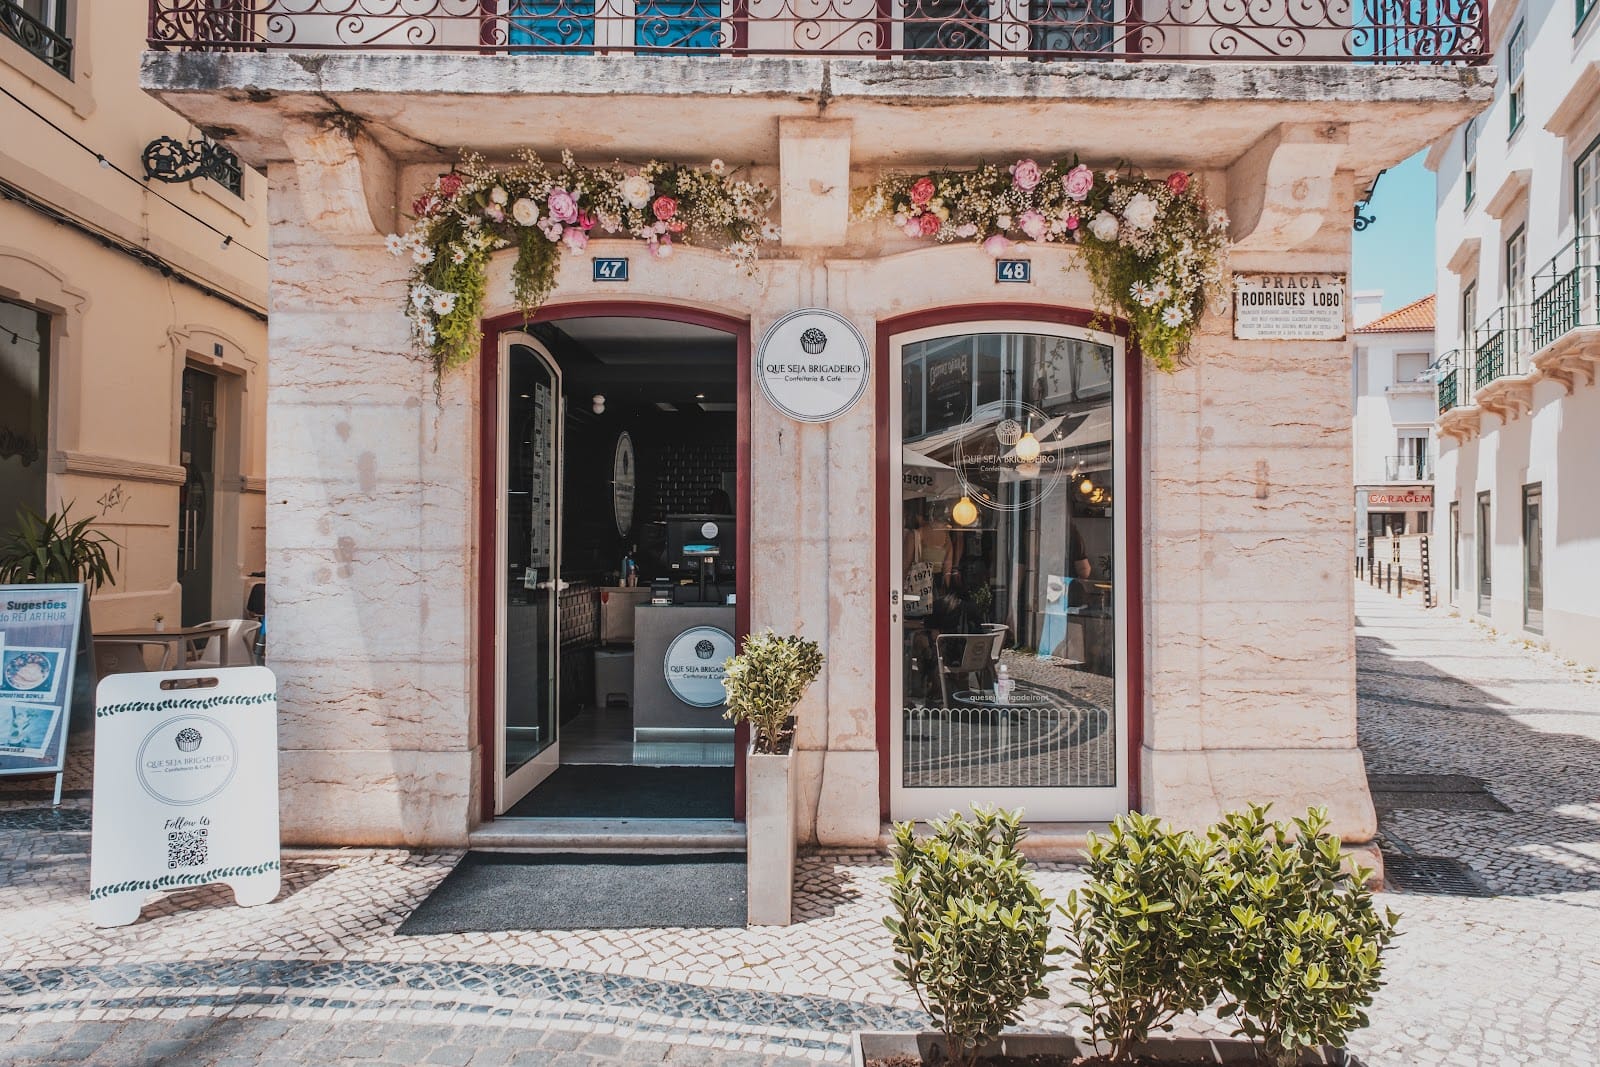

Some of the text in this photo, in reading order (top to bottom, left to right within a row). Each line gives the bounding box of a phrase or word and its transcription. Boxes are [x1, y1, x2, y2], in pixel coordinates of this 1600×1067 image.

[600, 261, 622, 278] 47
[1002, 262, 1025, 279] 48
[1241, 291, 1340, 307] RODRIGUES LOBO
[766, 364, 861, 374] QUE SEJA BRIGADEIRO
[962, 455, 982, 465] QUE
[983, 455, 1002, 464] SEJA
[6, 599, 67, 613] Sugestões
[12, 612, 27, 622] REI
[30, 611, 66, 622] ARTHUR
[670, 665, 685, 673] QUE
[686, 665, 699, 673] SEJA
[146, 760, 165, 769] QUE
[164, 816, 196, 830] Follow
